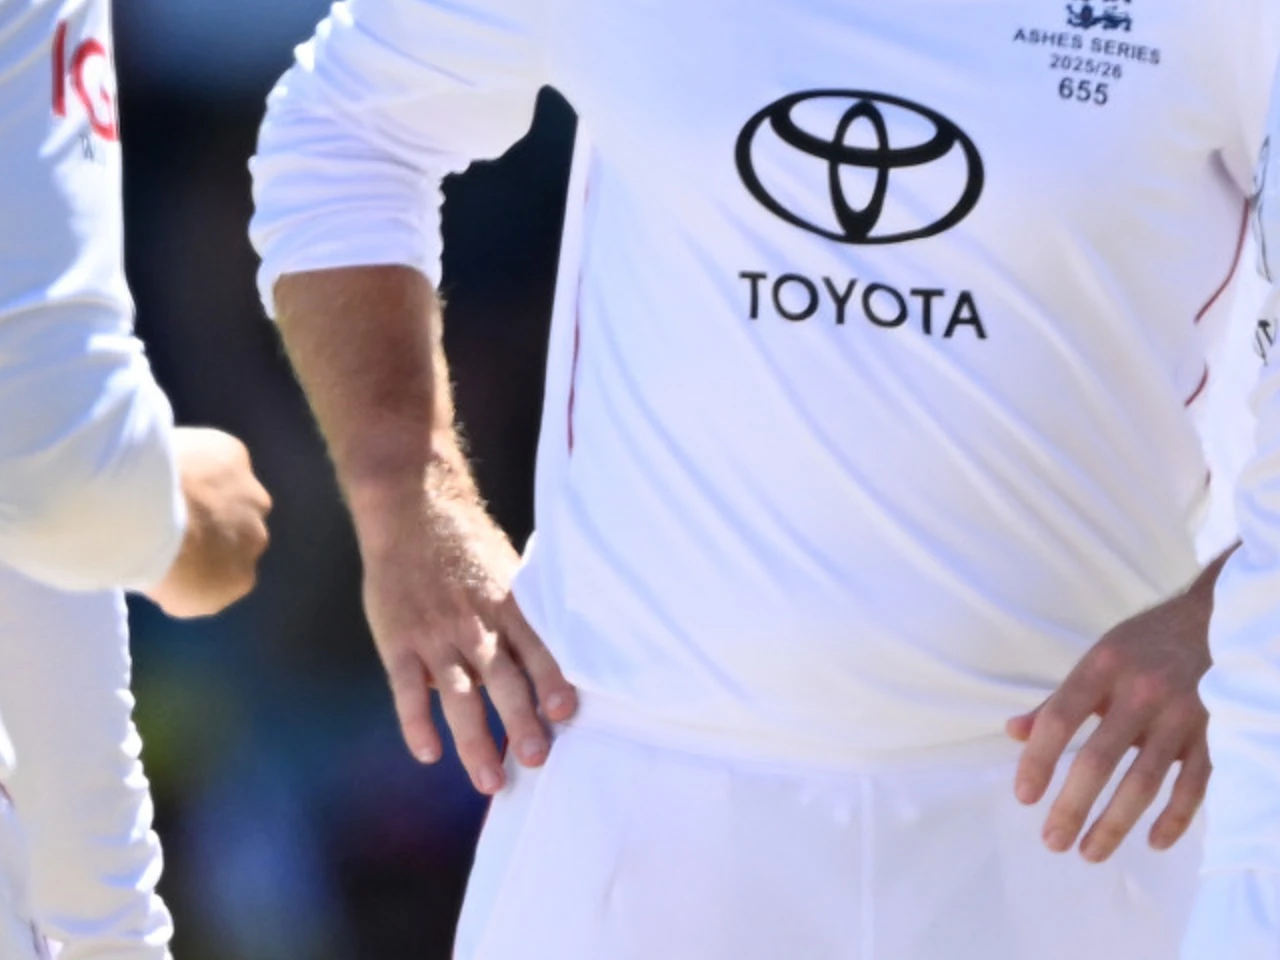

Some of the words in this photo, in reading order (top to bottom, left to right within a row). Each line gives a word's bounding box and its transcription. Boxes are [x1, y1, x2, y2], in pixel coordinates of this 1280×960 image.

[1013, 27, 1083, 50] ASHES
[1090, 37, 1162, 65] SERIES
[1049, 52, 1123, 79] 2025/26
[1058, 77, 1109, 106] 655
[738, 270, 988, 340] TOYOTA
